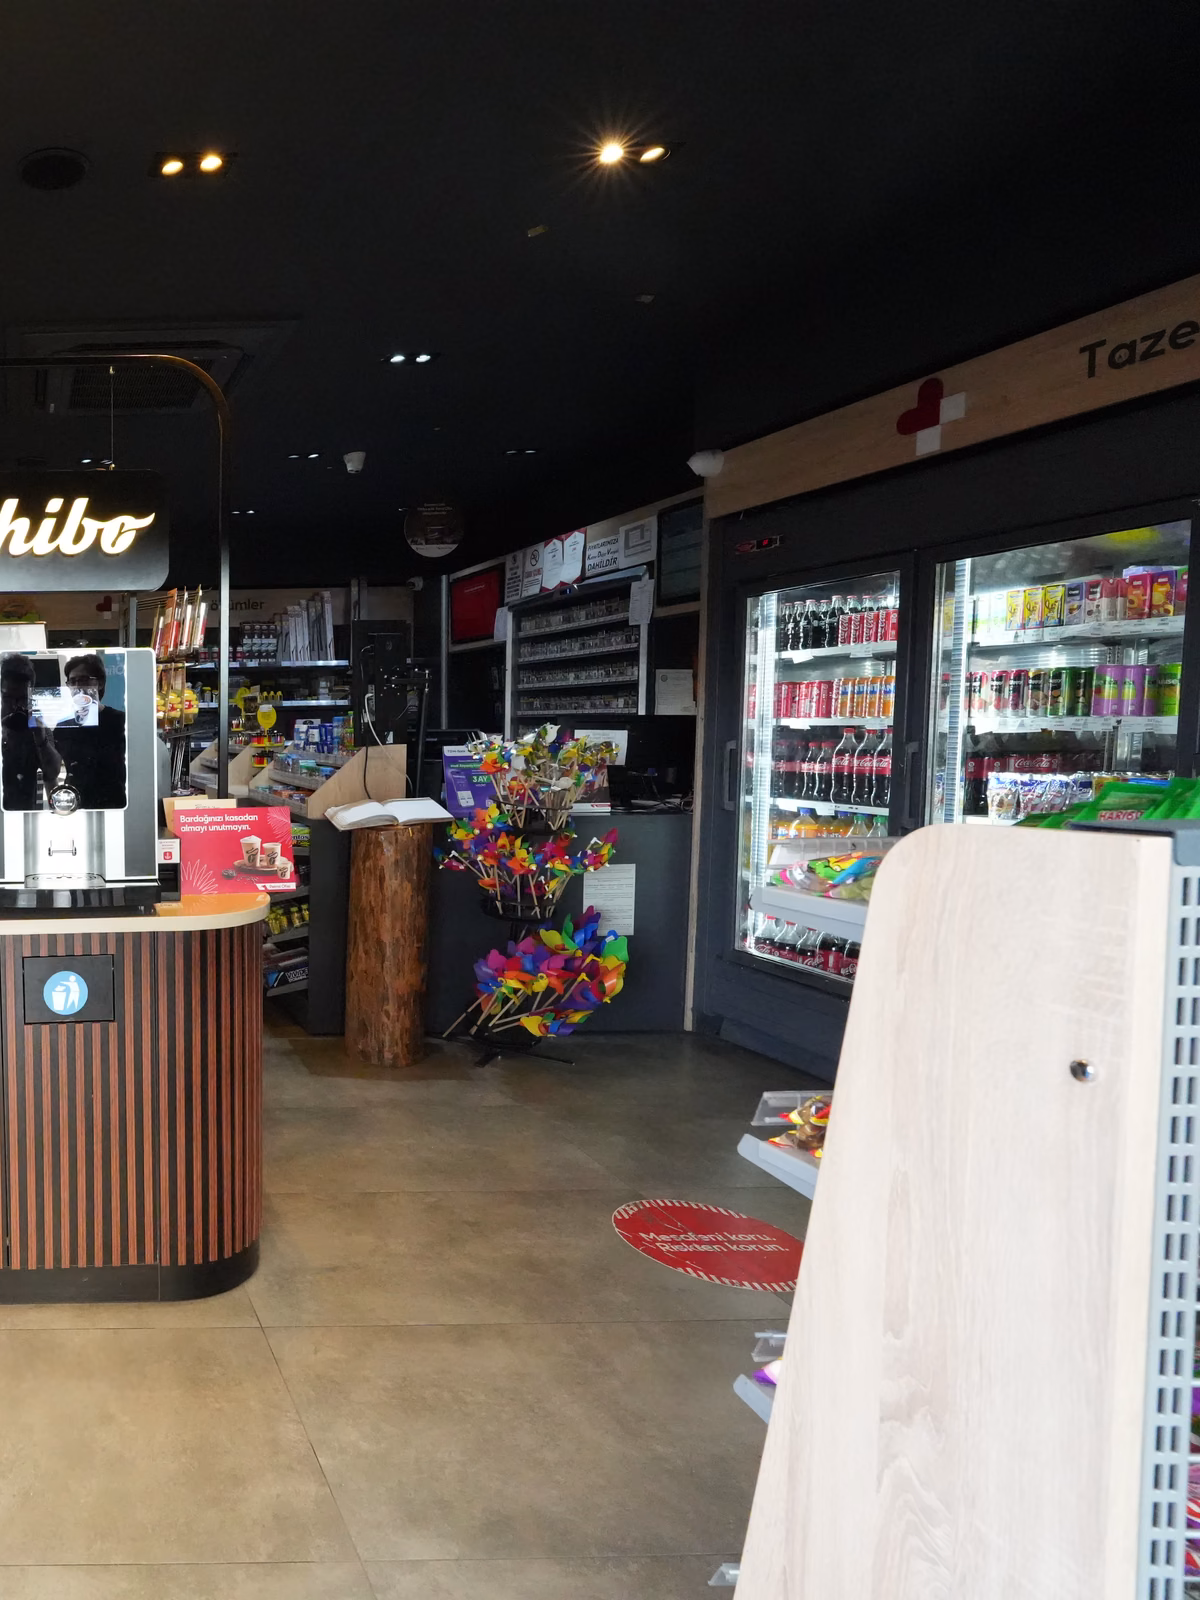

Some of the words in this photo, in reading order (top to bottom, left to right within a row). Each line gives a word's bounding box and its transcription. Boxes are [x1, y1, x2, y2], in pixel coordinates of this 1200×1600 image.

[1079, 319, 1200, 379] Taze
[180, 814, 223, 824] Bardağınızı
[225, 812, 258, 822] kasadan
[181, 824, 208, 834] almayı
[208, 824, 251, 832] unutmayın.
[638, 1232, 728, 1242] Mesafeni
[723, 1232, 777, 1241] koru.
[724, 1242, 790, 1252] korun.
